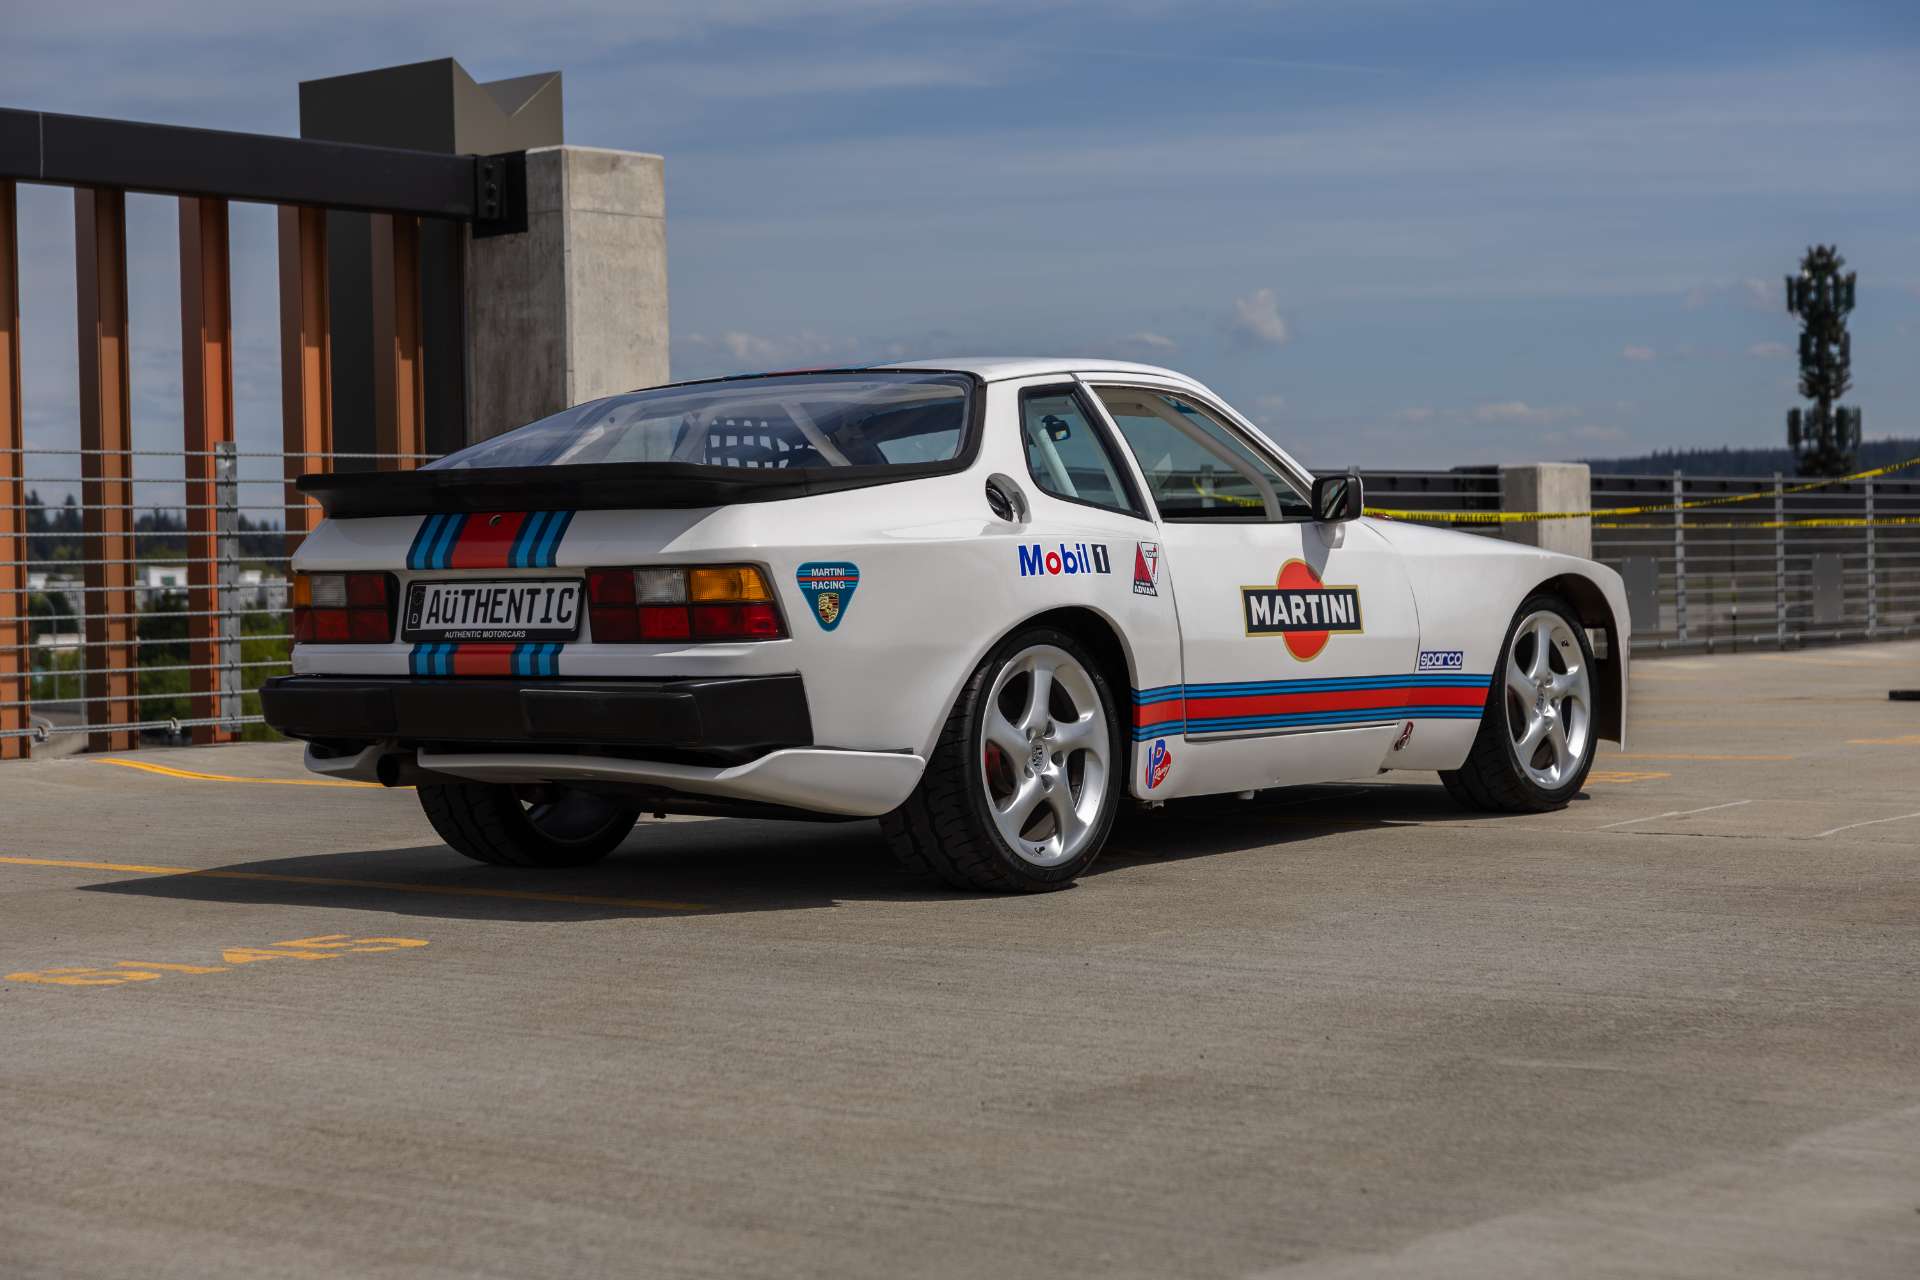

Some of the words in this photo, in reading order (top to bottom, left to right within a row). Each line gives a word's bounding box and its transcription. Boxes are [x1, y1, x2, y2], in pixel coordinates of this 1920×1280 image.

[1018, 543, 1091, 576] Mobil
[811, 568, 845, 577] MARTINI
[811, 581, 846, 590] RACING
[1249, 594, 1356, 626] MARTINI
[411, 613, 419, 624] D
[444, 631, 482, 639] AUTHENTIC
[482, 630, 527, 638] MOTORCARS
[1420, 652, 1462, 669] sparco
